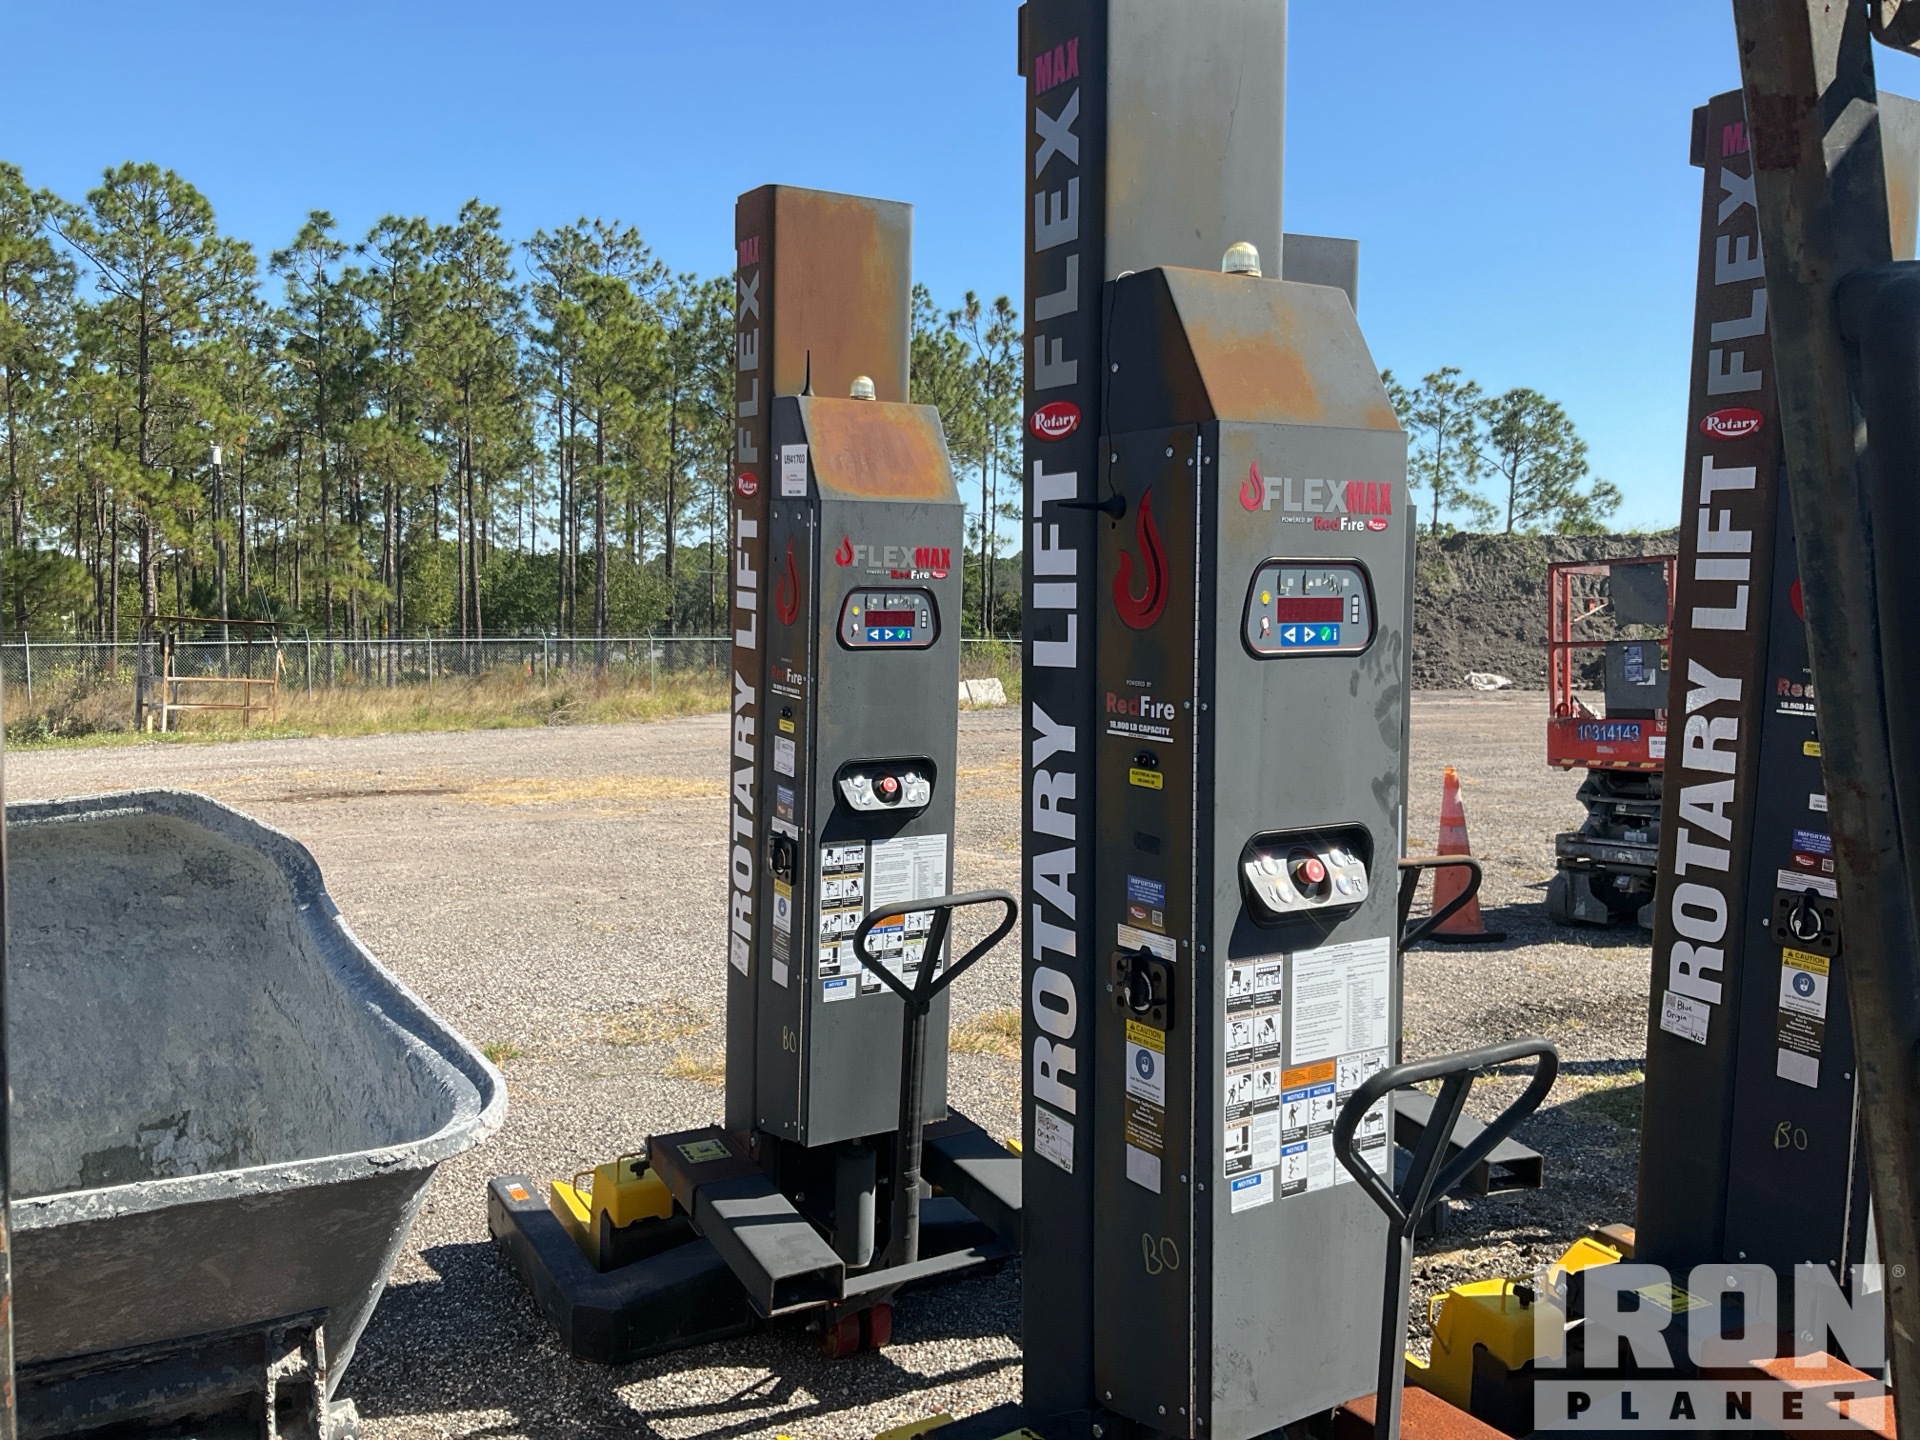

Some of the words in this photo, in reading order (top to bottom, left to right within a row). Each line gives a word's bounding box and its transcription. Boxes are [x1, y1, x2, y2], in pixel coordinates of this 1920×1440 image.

[1035, 37, 1080, 95] MAX
[1034, 87, 1080, 391] FLEX
[1707, 167, 1766, 396] FLEX
[737, 270, 760, 464] FLEX
[1035, 413, 1077, 435] Rotary
[1706, 416, 1758, 436] Rotary
[1281, 516, 1306, 524] POWERED
[1314, 516, 1365, 531] RedFire
[1691, 455, 1757, 631] LIFT
[1033, 459, 1078, 669] LIFT
[735, 509, 758, 650] LIFT
[1126, 679, 1146, 688] POWERED
[1106, 691, 1175, 721] RedFire
[1130, 722, 1139, 732] LB
[1139, 724, 1171, 736] CAPACITY
[732, 669, 756, 942] ROTARY
[1668, 658, 1743, 1005] ROTARY
[1797, 831, 1832, 842] IMPORTAN
[1130, 878, 1162, 890] IMPORTANT
[1031, 701, 1077, 1115] ROTARY
[1795, 952, 1826, 965] CAUTION
[1677, 1000, 1692, 1011] Blue
[1666, 1010, 1687, 1022] Origin
[1135, 1024, 1162, 1040] CAUTION
[1287, 1092, 1305, 1102] NOTICE
[1314, 1086, 1332, 1096] NOTICE
[1037, 1128, 1056, 1144] Origin
[1774, 1120, 1808, 1150] BO
[1287, 1144, 1305, 1154] NOTICE
[1237, 1176, 1258, 1188] NOTICE
[1141, 1232, 1179, 1275] BO
